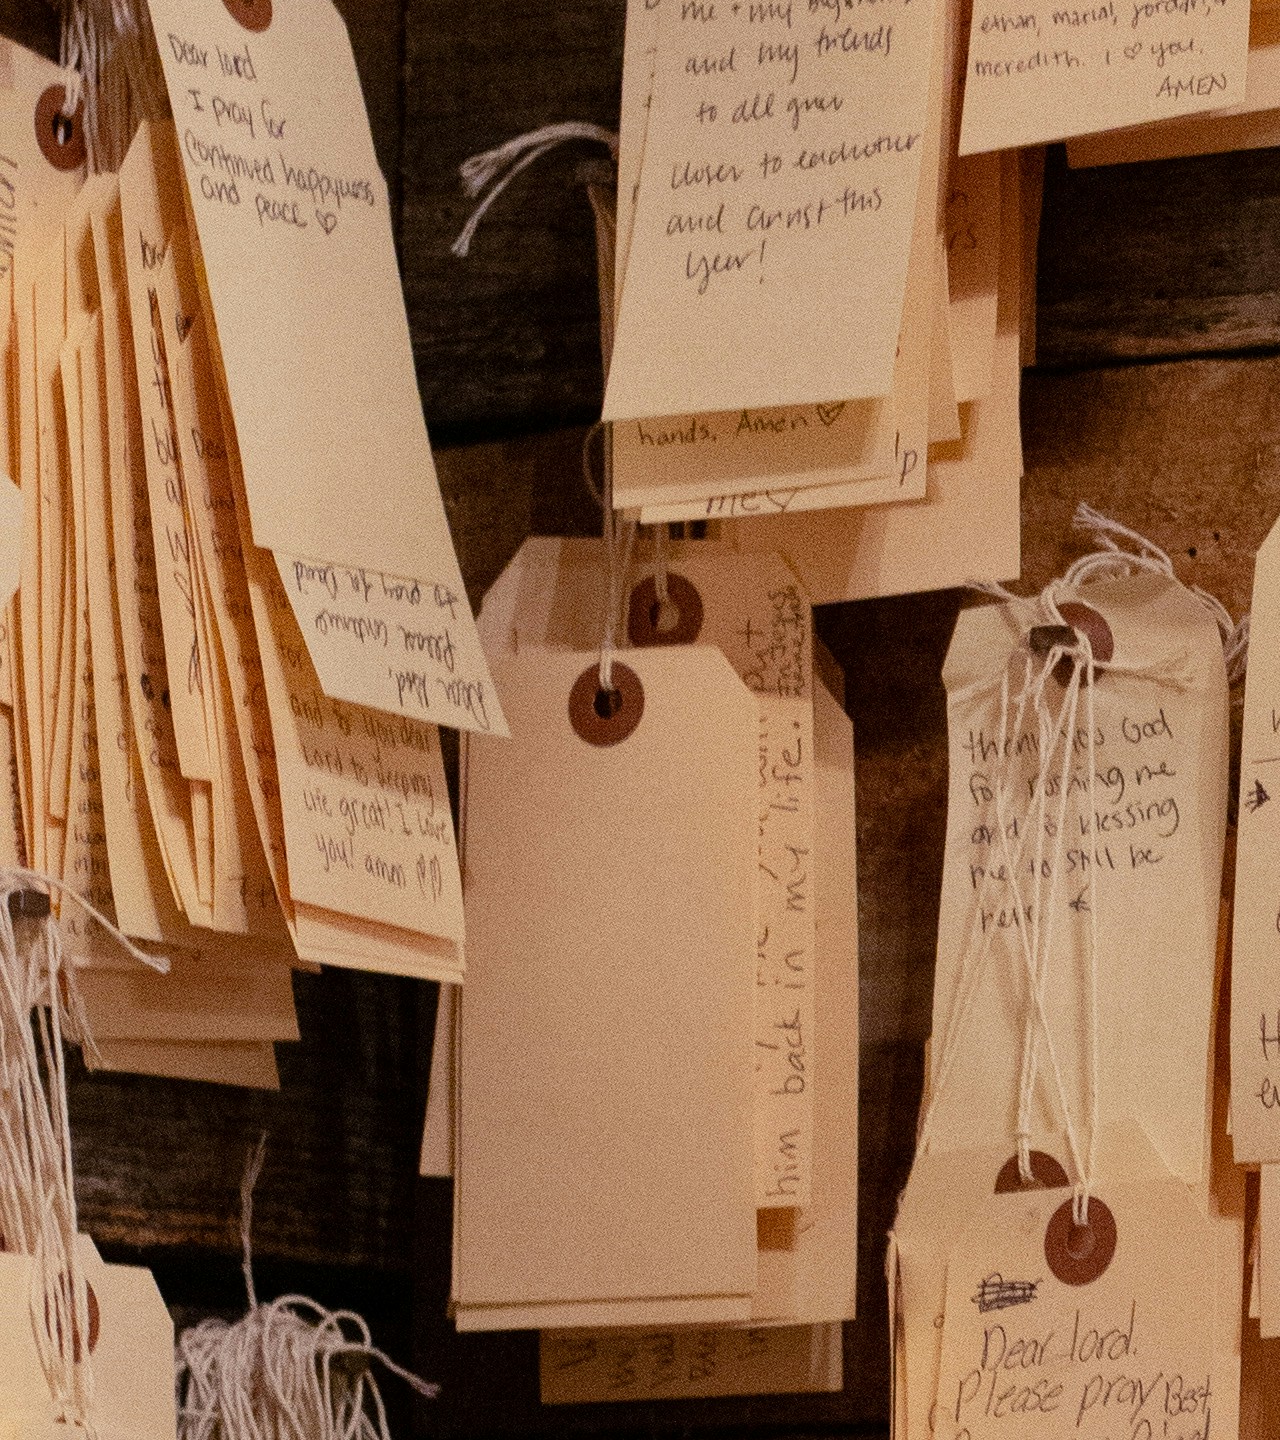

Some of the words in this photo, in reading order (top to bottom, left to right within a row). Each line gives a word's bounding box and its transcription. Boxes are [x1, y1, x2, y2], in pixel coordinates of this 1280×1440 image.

[168, 32, 208, 68] Dear
[188, 89, 204, 112] I
[212, 96, 255, 138] pray
[1121, 708, 1174, 744] God
[980, 1324, 1054, 1371] Dear
[1076, 1372, 1162, 1427] pray
